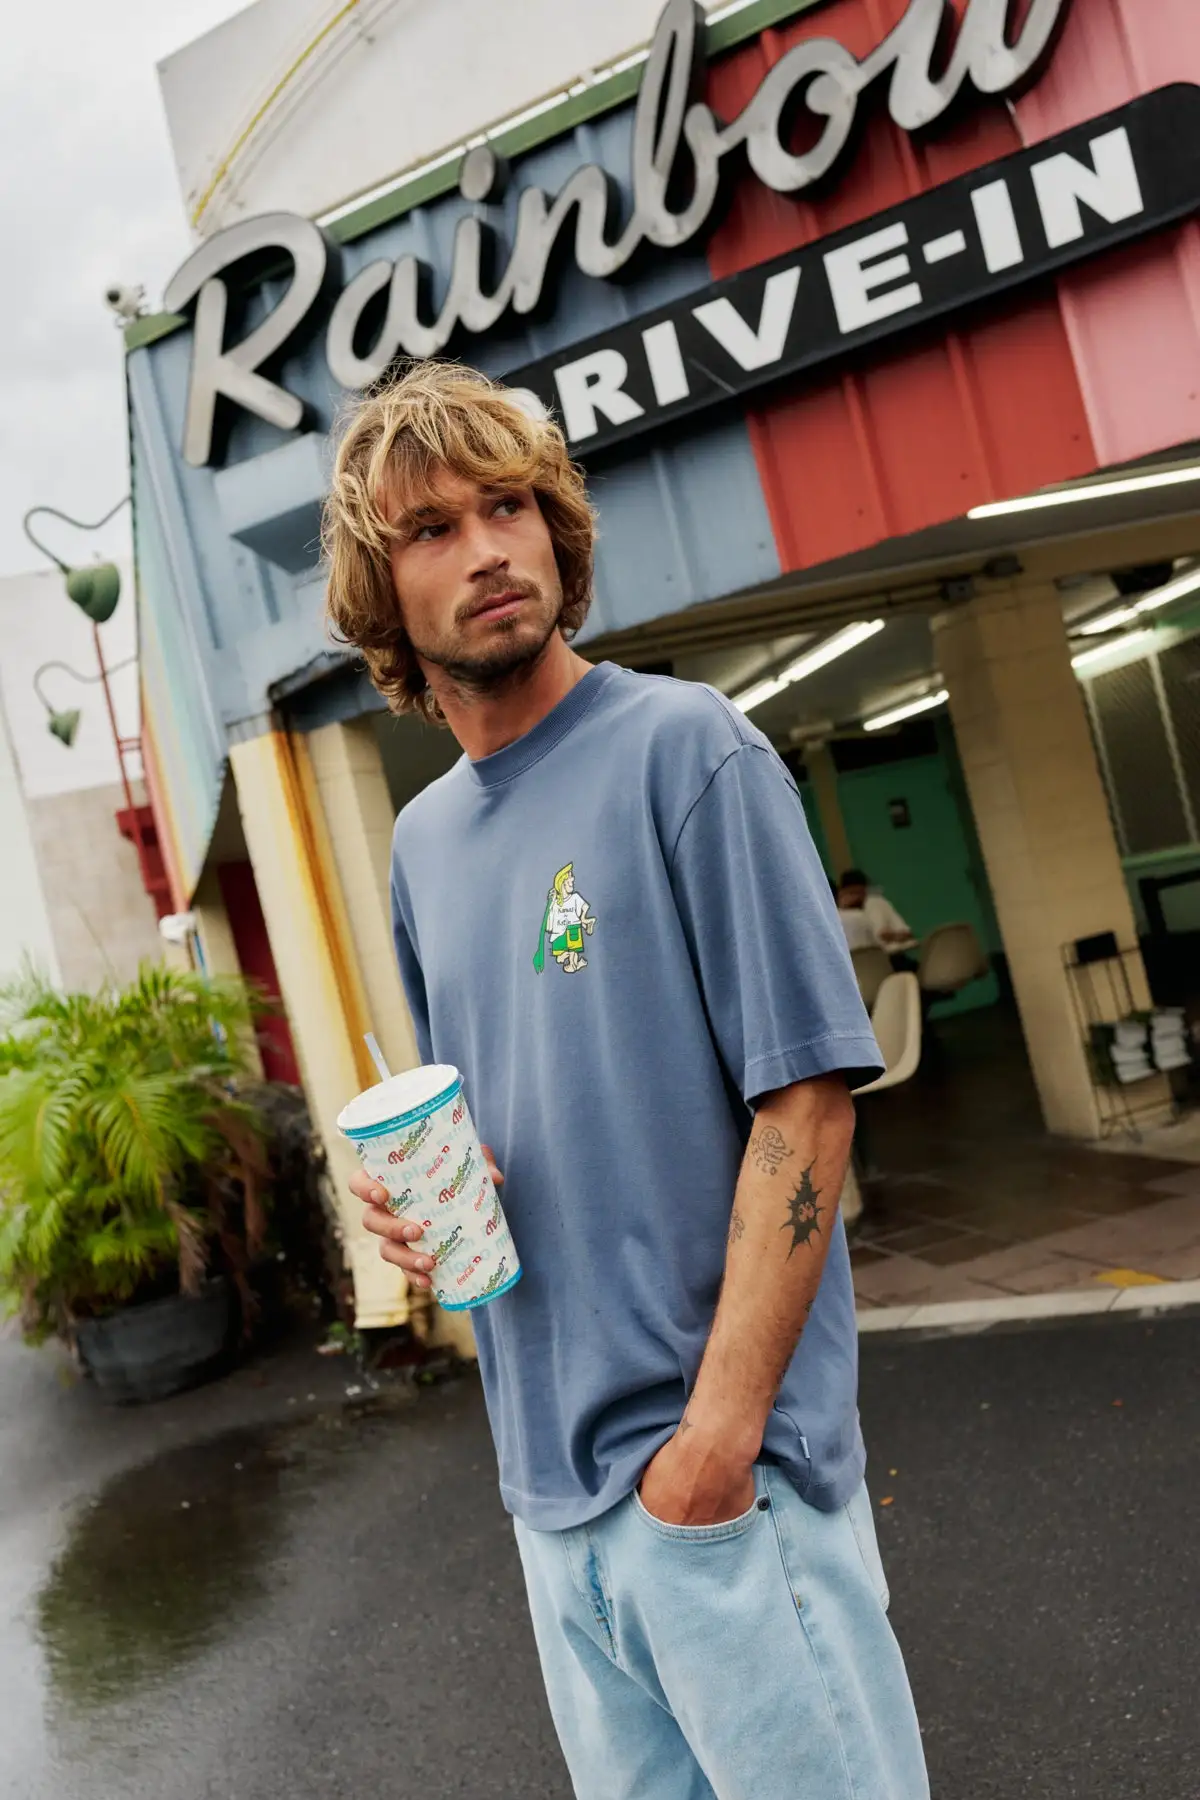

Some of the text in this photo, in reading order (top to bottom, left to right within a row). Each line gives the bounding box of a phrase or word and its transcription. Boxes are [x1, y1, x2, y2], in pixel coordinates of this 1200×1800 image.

[164, 0, 1060, 467] Rainbow
[388, 1115, 430, 1164] Rainbow
[438, 1146, 472, 1203] Rainbow
